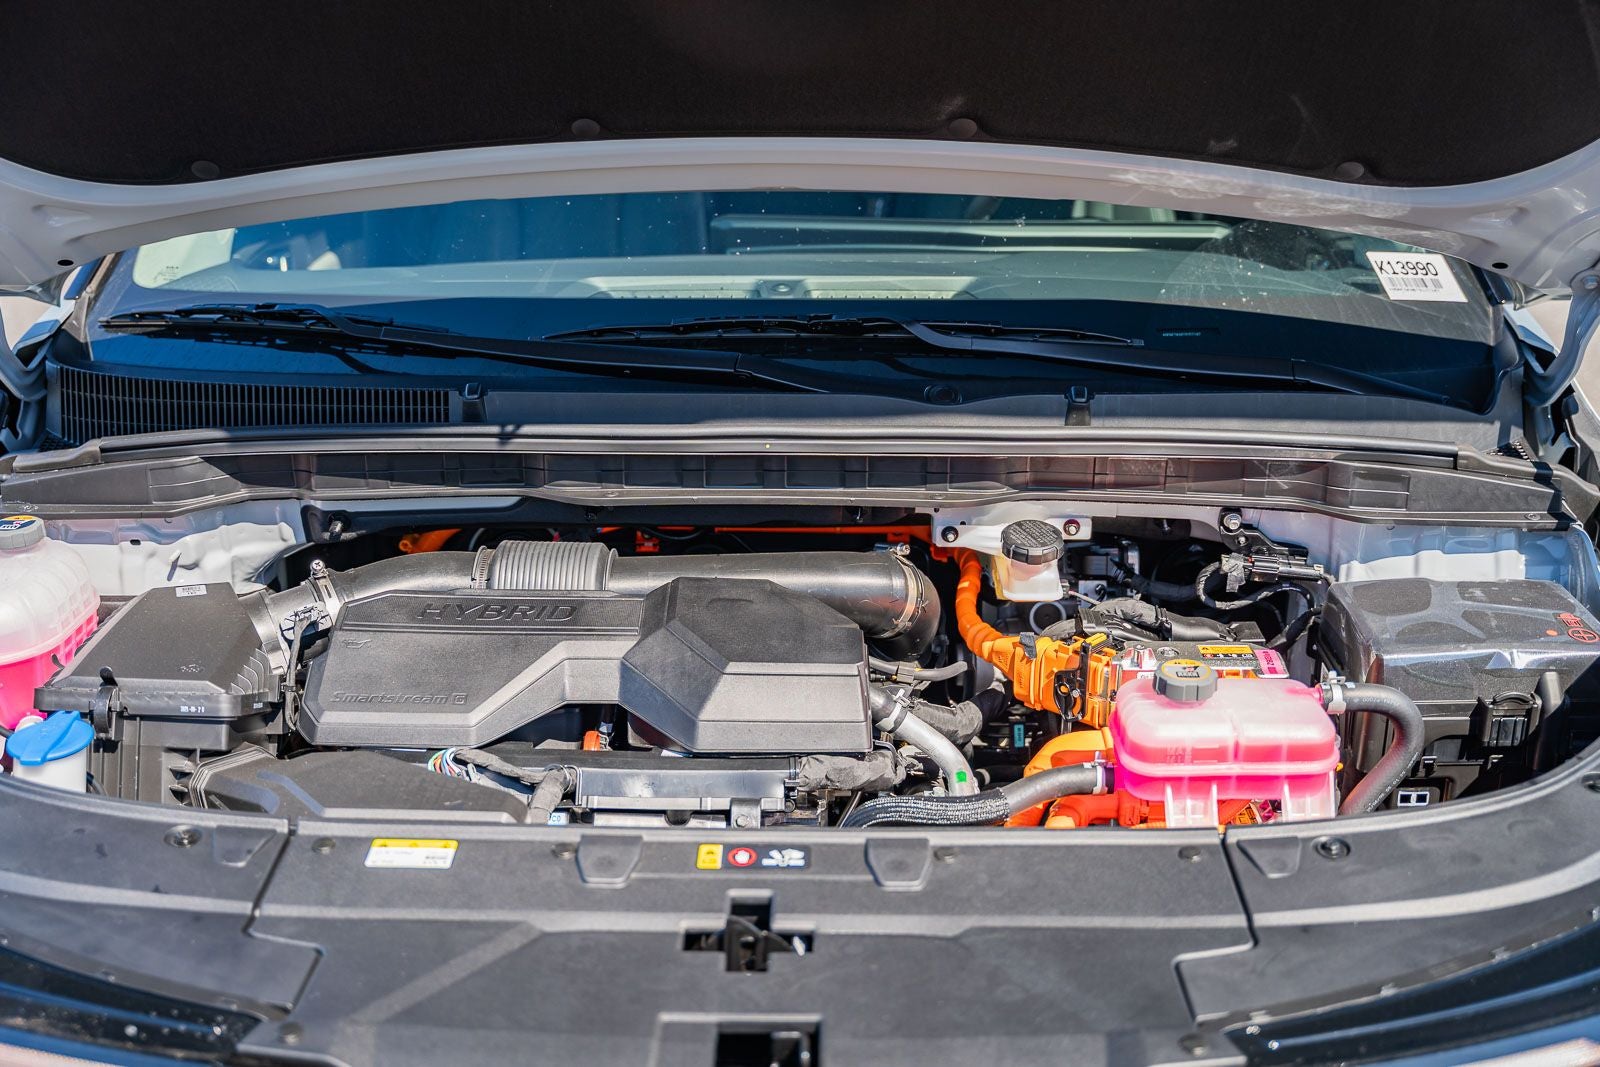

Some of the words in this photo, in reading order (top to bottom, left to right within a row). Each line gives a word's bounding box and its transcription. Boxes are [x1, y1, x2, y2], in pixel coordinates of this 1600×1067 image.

[1375, 260, 1439, 277] K13990
[416, 603, 578, 622] HYBRID
[330, 690, 449, 705] Smartstream
